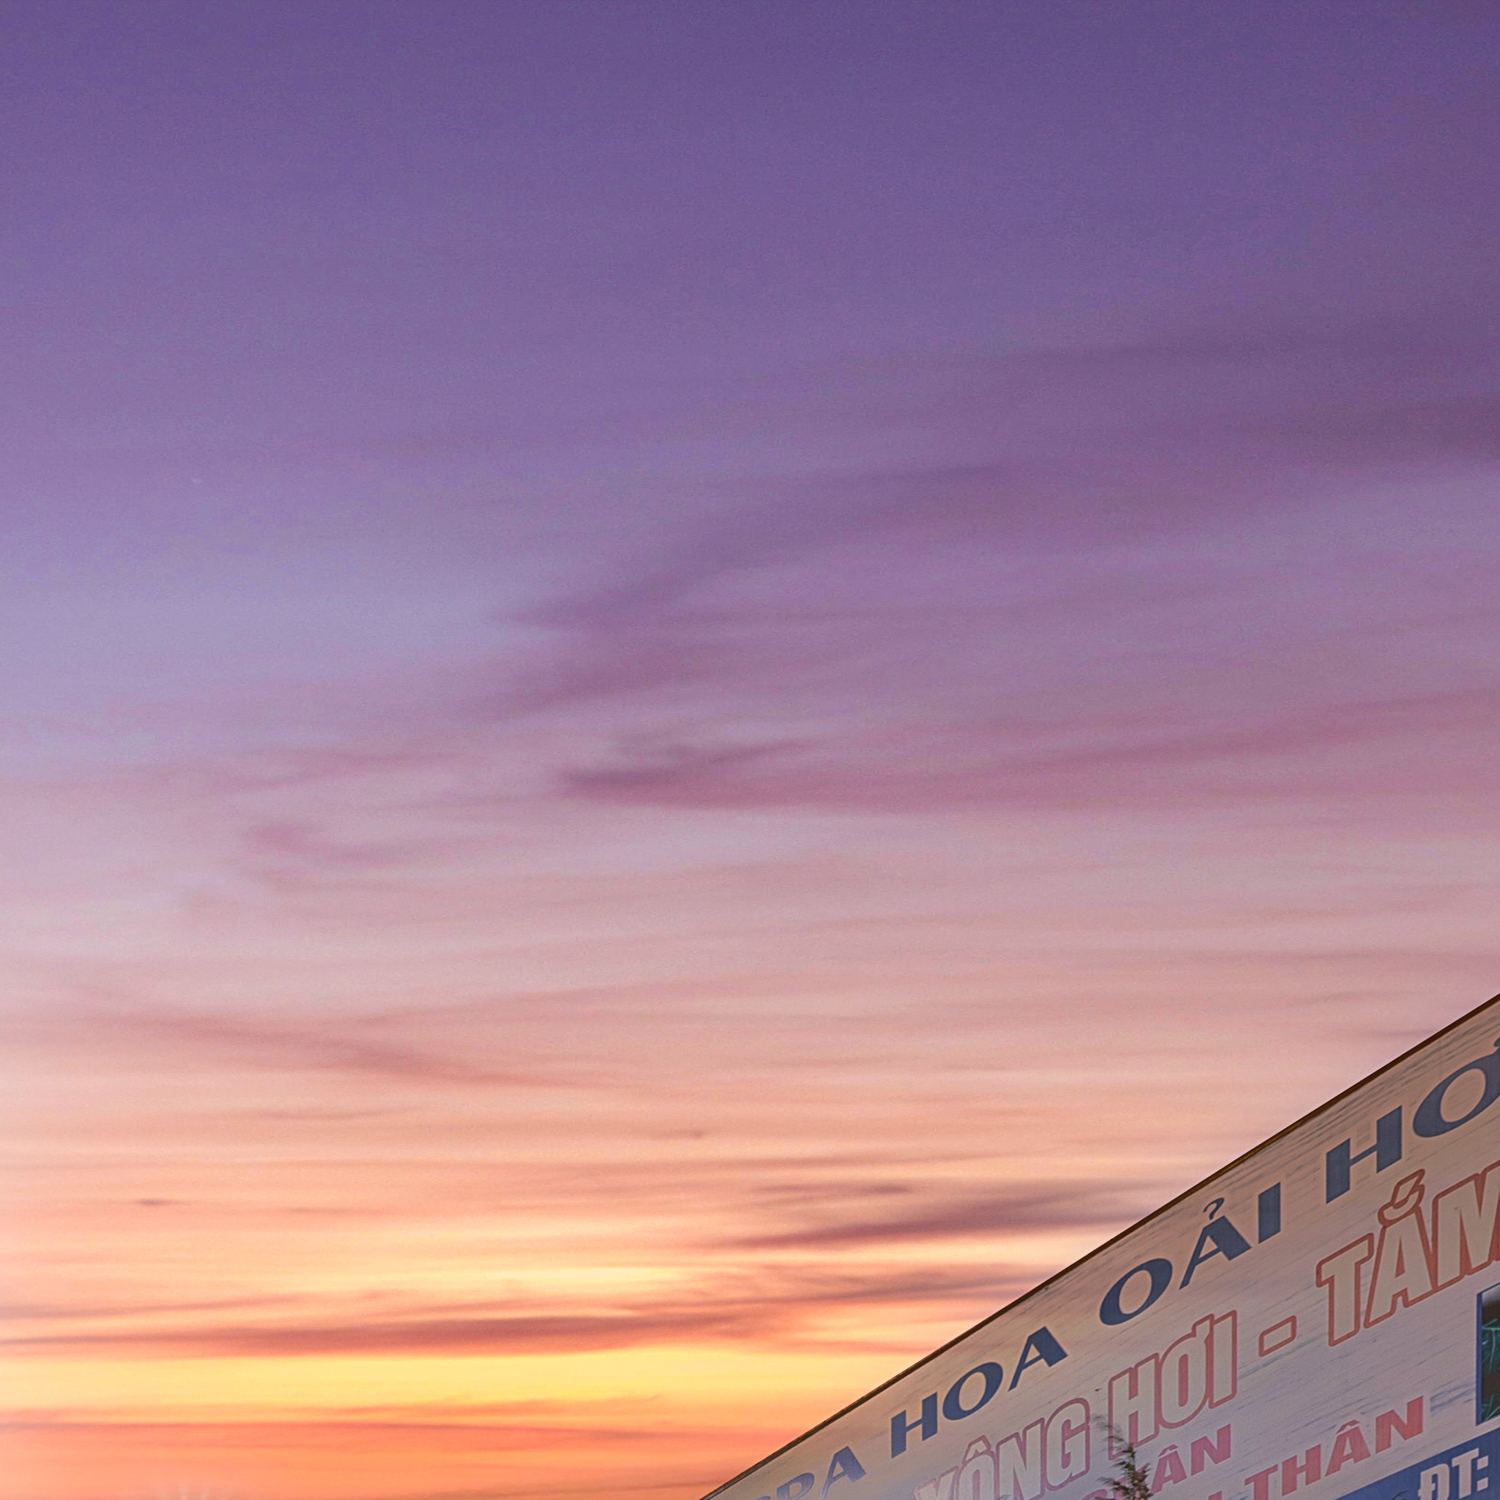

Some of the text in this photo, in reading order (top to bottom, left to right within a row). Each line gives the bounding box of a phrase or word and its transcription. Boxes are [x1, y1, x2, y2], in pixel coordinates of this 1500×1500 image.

[890, 1326, 1068, 1459] HOA
[1099, 1181, 1282, 1326] OẢI
[1107, 1309, 1238, 1461] HƠI
